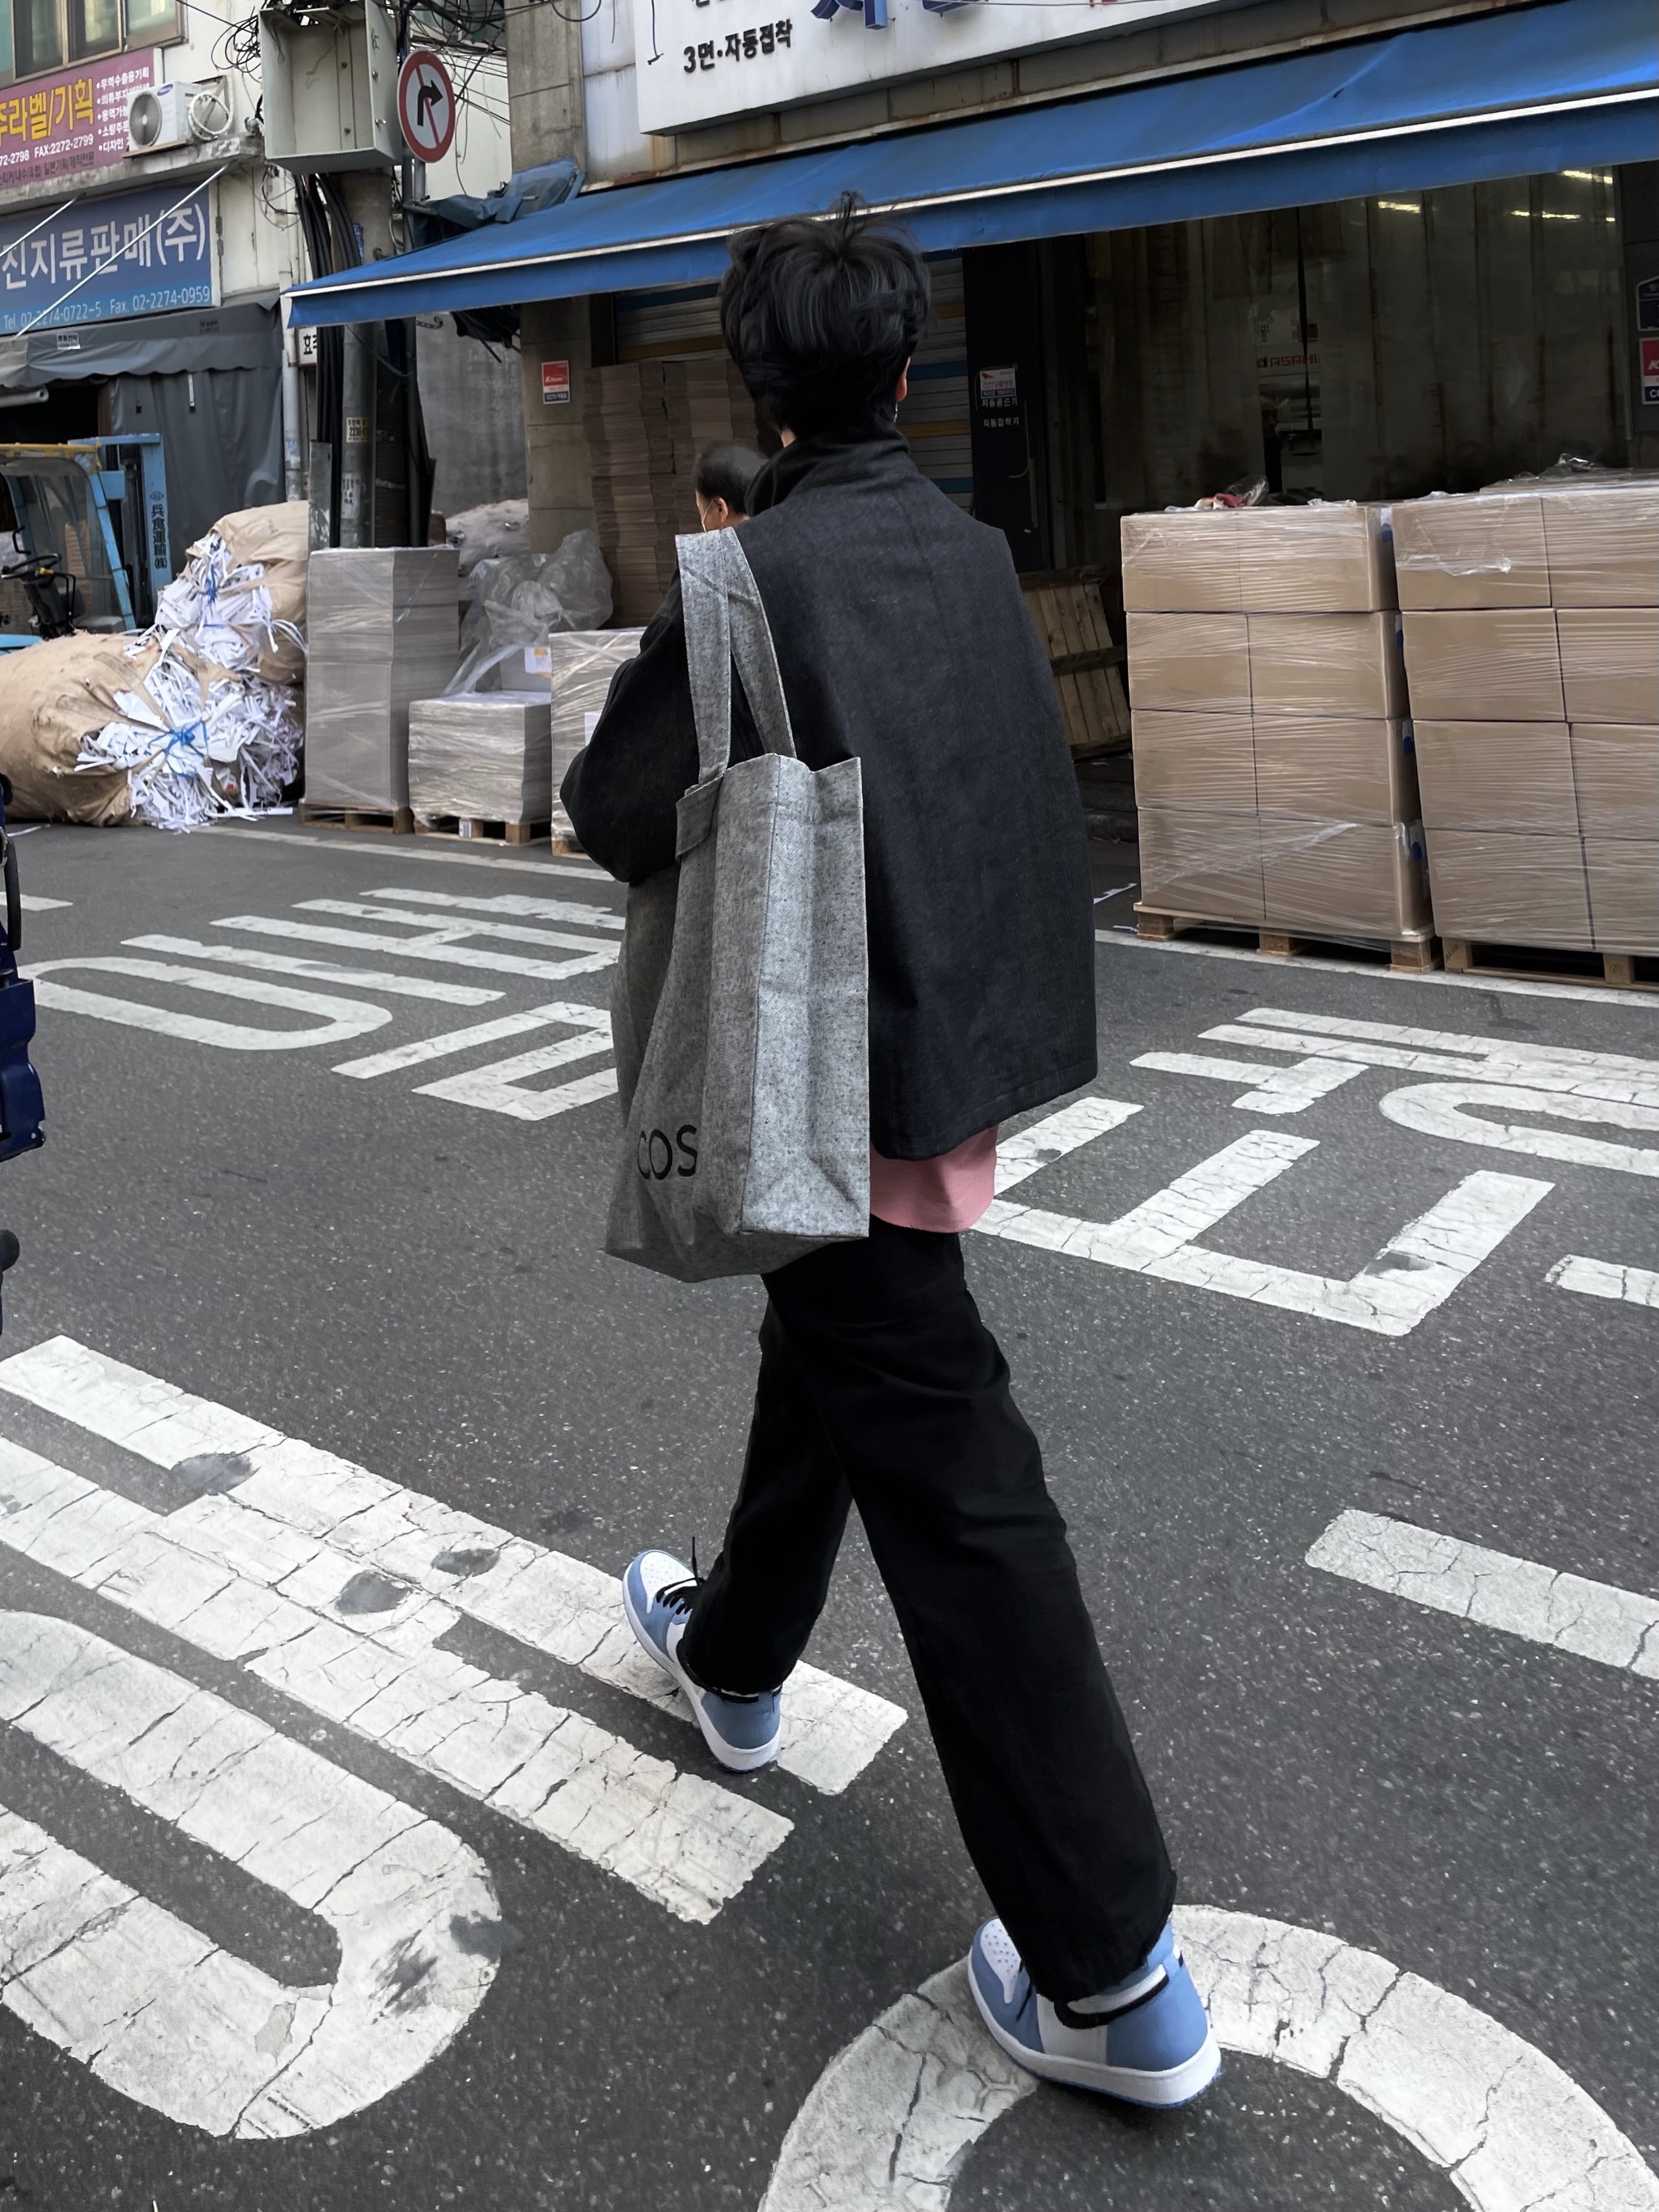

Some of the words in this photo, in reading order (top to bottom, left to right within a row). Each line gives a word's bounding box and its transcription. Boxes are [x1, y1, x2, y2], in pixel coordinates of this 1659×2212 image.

[4, 312, 19, 330] Tel.
[110, 298, 130, 315] Fax.
[133, 285, 210, 311] 02-2274-0959
[637, 1124, 698, 1180] COS
